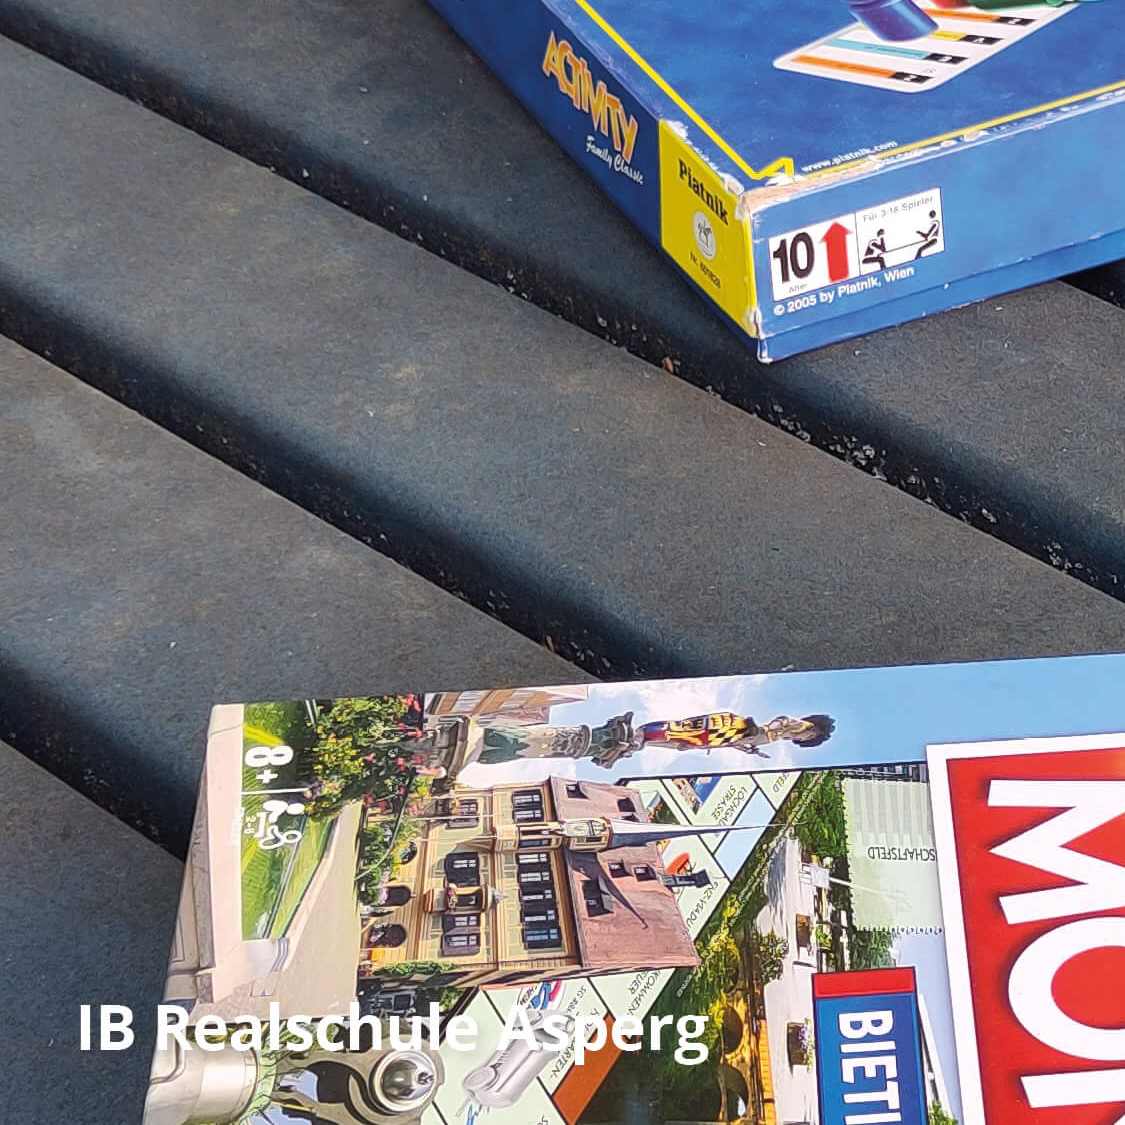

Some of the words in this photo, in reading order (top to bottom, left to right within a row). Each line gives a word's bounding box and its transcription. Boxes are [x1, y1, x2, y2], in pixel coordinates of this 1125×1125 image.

[542, 30, 639, 163] ACTIVITY
[586, 135, 613, 169] Family
[614, 154, 643, 186] Classic
[679, 158, 729, 226] Piatnik
[773, 232, 815, 283] 10
[787, 294, 817, 313] 2005
[819, 290, 835, 304] by
[883, 266, 915, 283] Wien
[868, 846, 938, 861] SCHAFTSFELD
